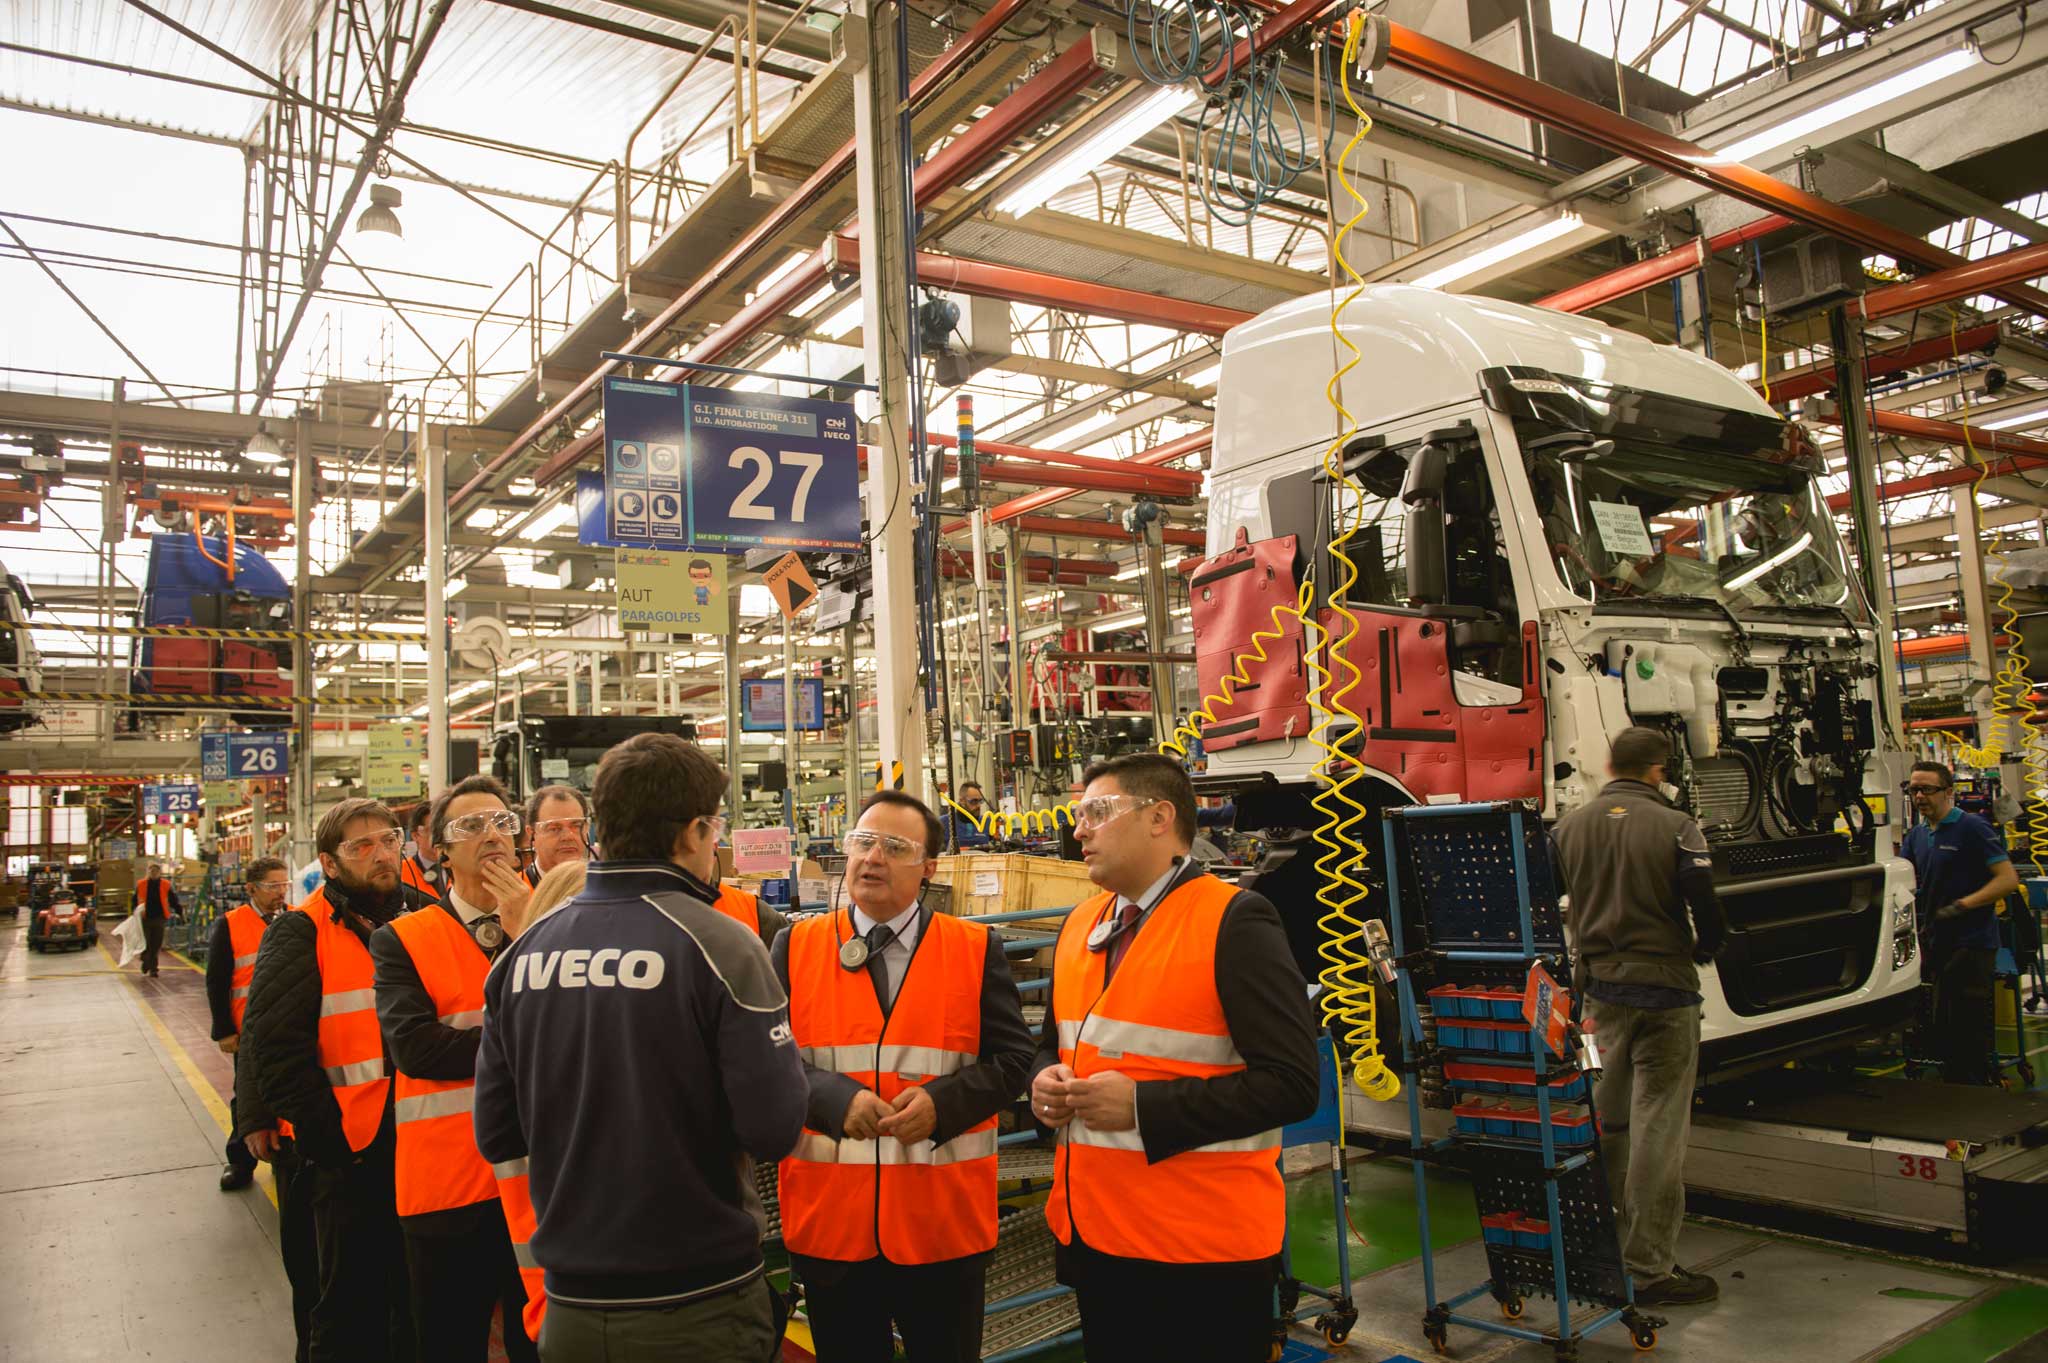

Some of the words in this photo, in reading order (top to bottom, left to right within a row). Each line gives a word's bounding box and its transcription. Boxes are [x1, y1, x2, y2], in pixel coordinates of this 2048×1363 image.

[694, 404, 712, 415] G.I.
[714, 406, 743, 418] FINAL
[745, 409, 758, 420] DE
[760, 411, 789, 422] LINEA
[791, 414, 808, 425] 311
[695, 415, 712, 425] U.O.
[714, 418, 778, 432] AUTOBASTIDOR
[823, 431, 851, 441] IVECO
[728, 446, 824, 523] 27
[767, 555, 797, 584] POKA-YOKE
[621, 588, 653, 602] AUT
[622, 609, 701, 623] PARAGOLPES
[241, 747, 277, 771] 26
[168, 793, 192, 810] 25
[512, 948, 665, 993] IVECO
[1898, 1154, 1937, 1181] 38
